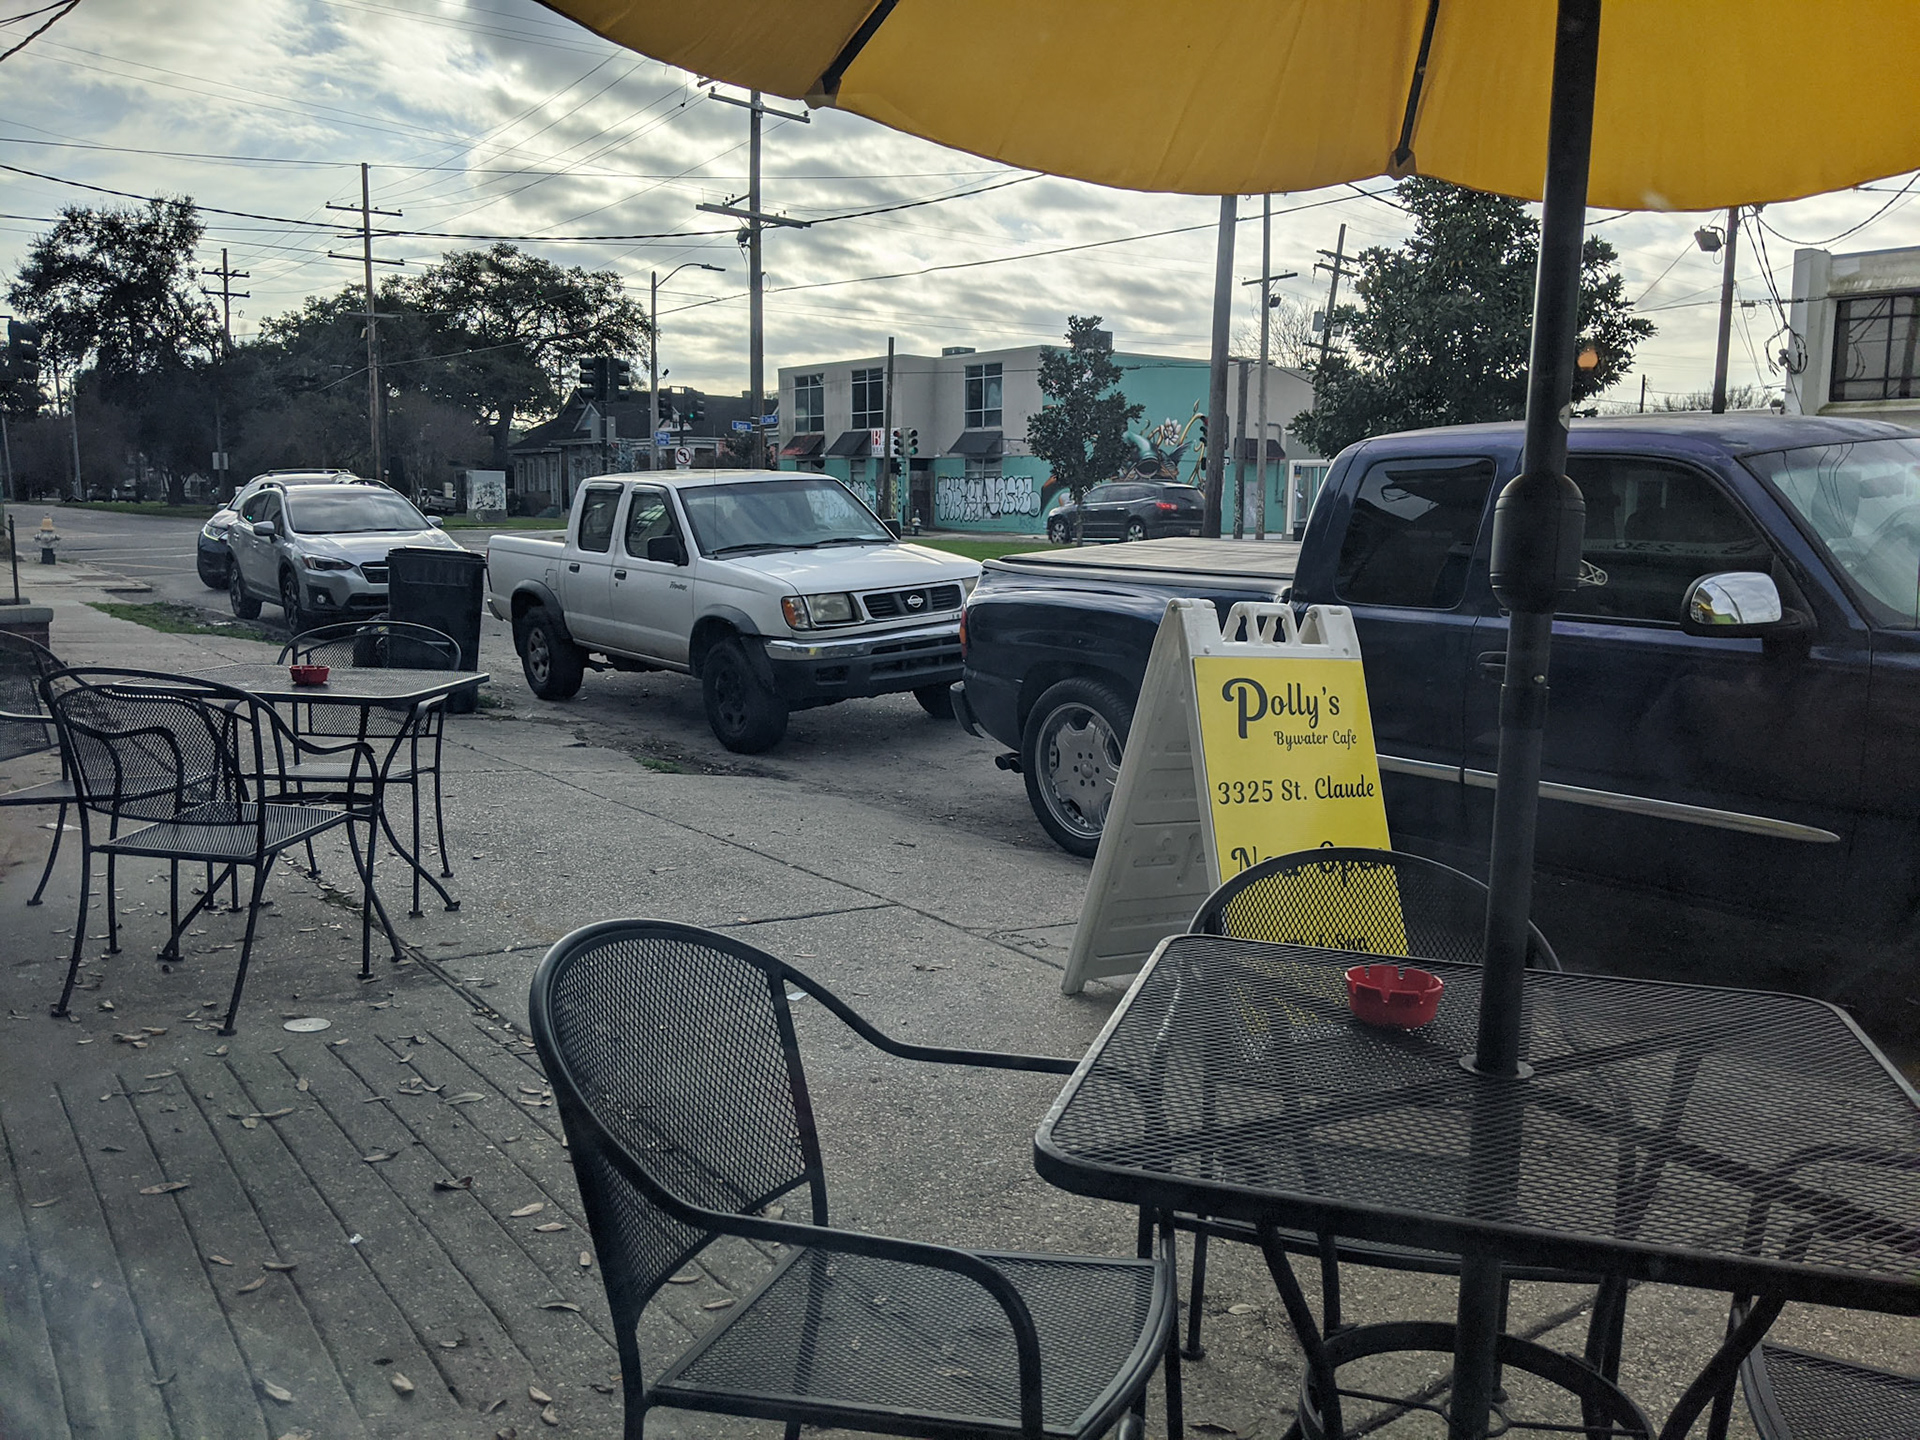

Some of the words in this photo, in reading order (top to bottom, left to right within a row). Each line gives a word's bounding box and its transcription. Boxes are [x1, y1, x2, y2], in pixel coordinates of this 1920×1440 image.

[1222, 678, 1340, 739] Polly's
[1274, 730, 1328, 751] Bywater
[1332, 729, 1357, 750] Cafe
[1218, 780, 1273, 805] 3325
[1281, 779, 1307, 801] St.
[1315, 774, 1374, 800] Claude
